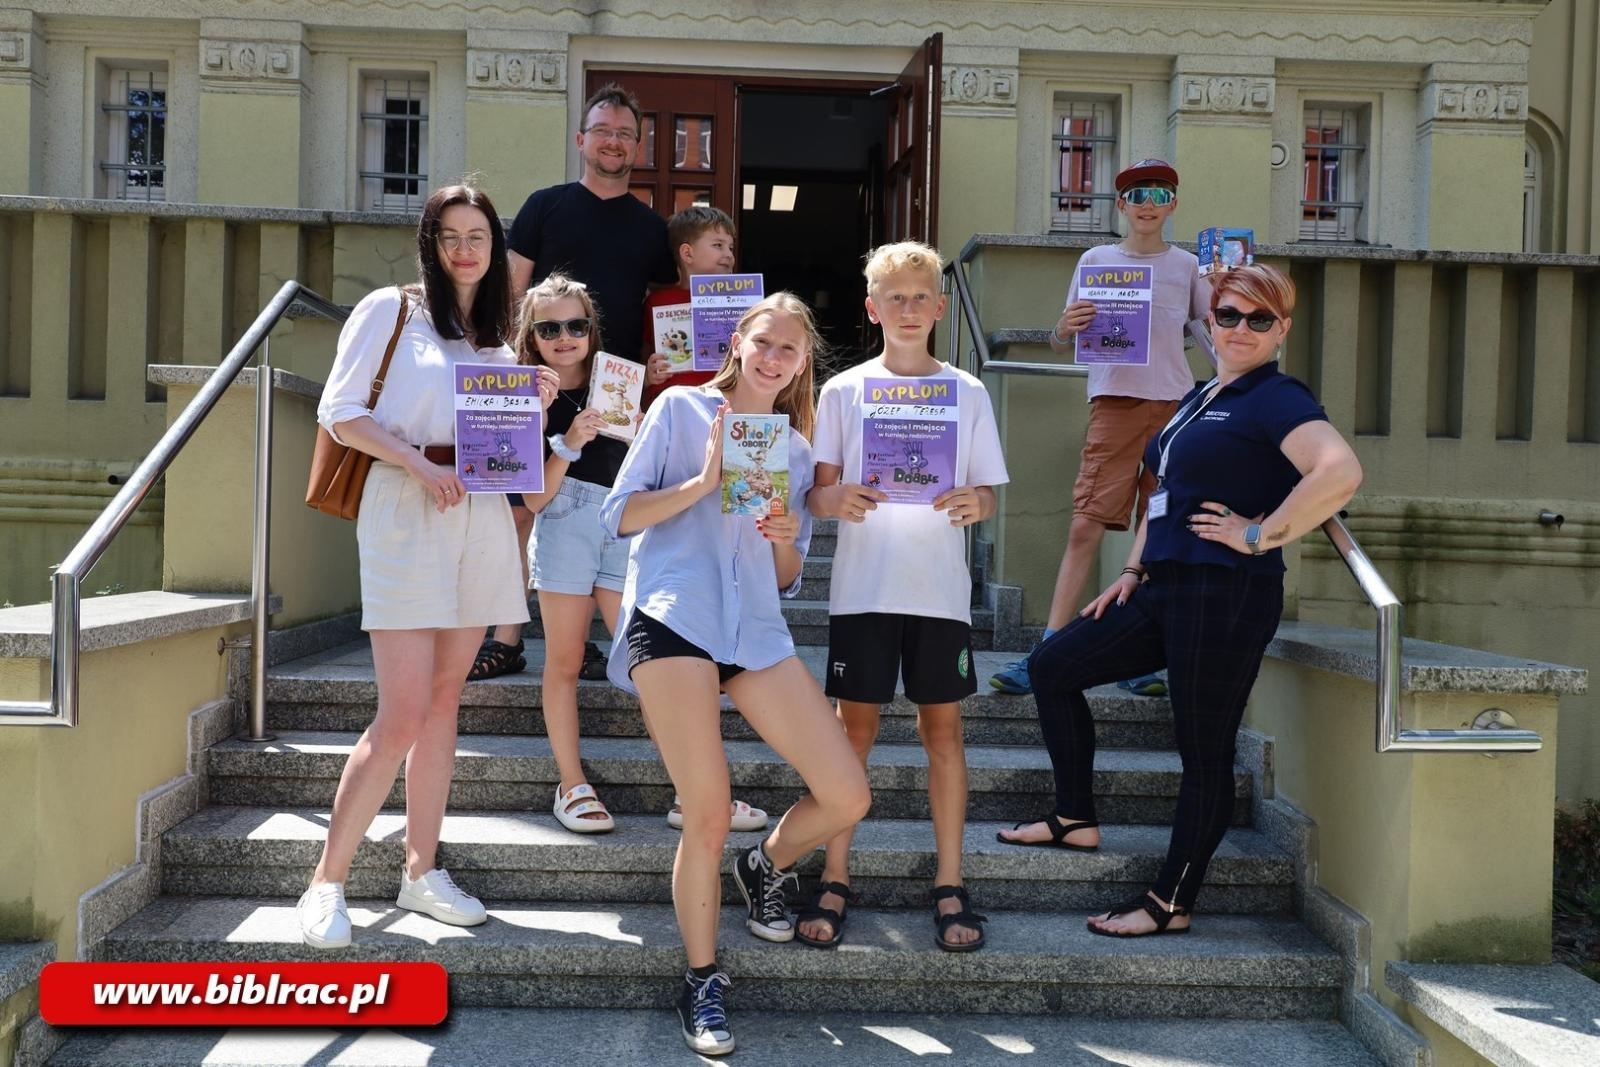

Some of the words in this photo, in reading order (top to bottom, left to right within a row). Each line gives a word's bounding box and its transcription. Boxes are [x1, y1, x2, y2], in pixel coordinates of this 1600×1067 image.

[1086, 271, 1144, 286] DYPLOM
[698, 279, 754, 294] DYPLOM
[605, 359, 639, 384] PIZZA
[463, 373, 531, 392] DYPLOM
[872, 383, 948, 401] DYPLOM
[913, 405, 946, 416] TERESA
[503, 415, 532, 423] miejsca
[913, 424, 946, 432] miejsca
[487, 457, 528, 472] DOBBLE
[894, 467, 939, 485] DOBBLE
